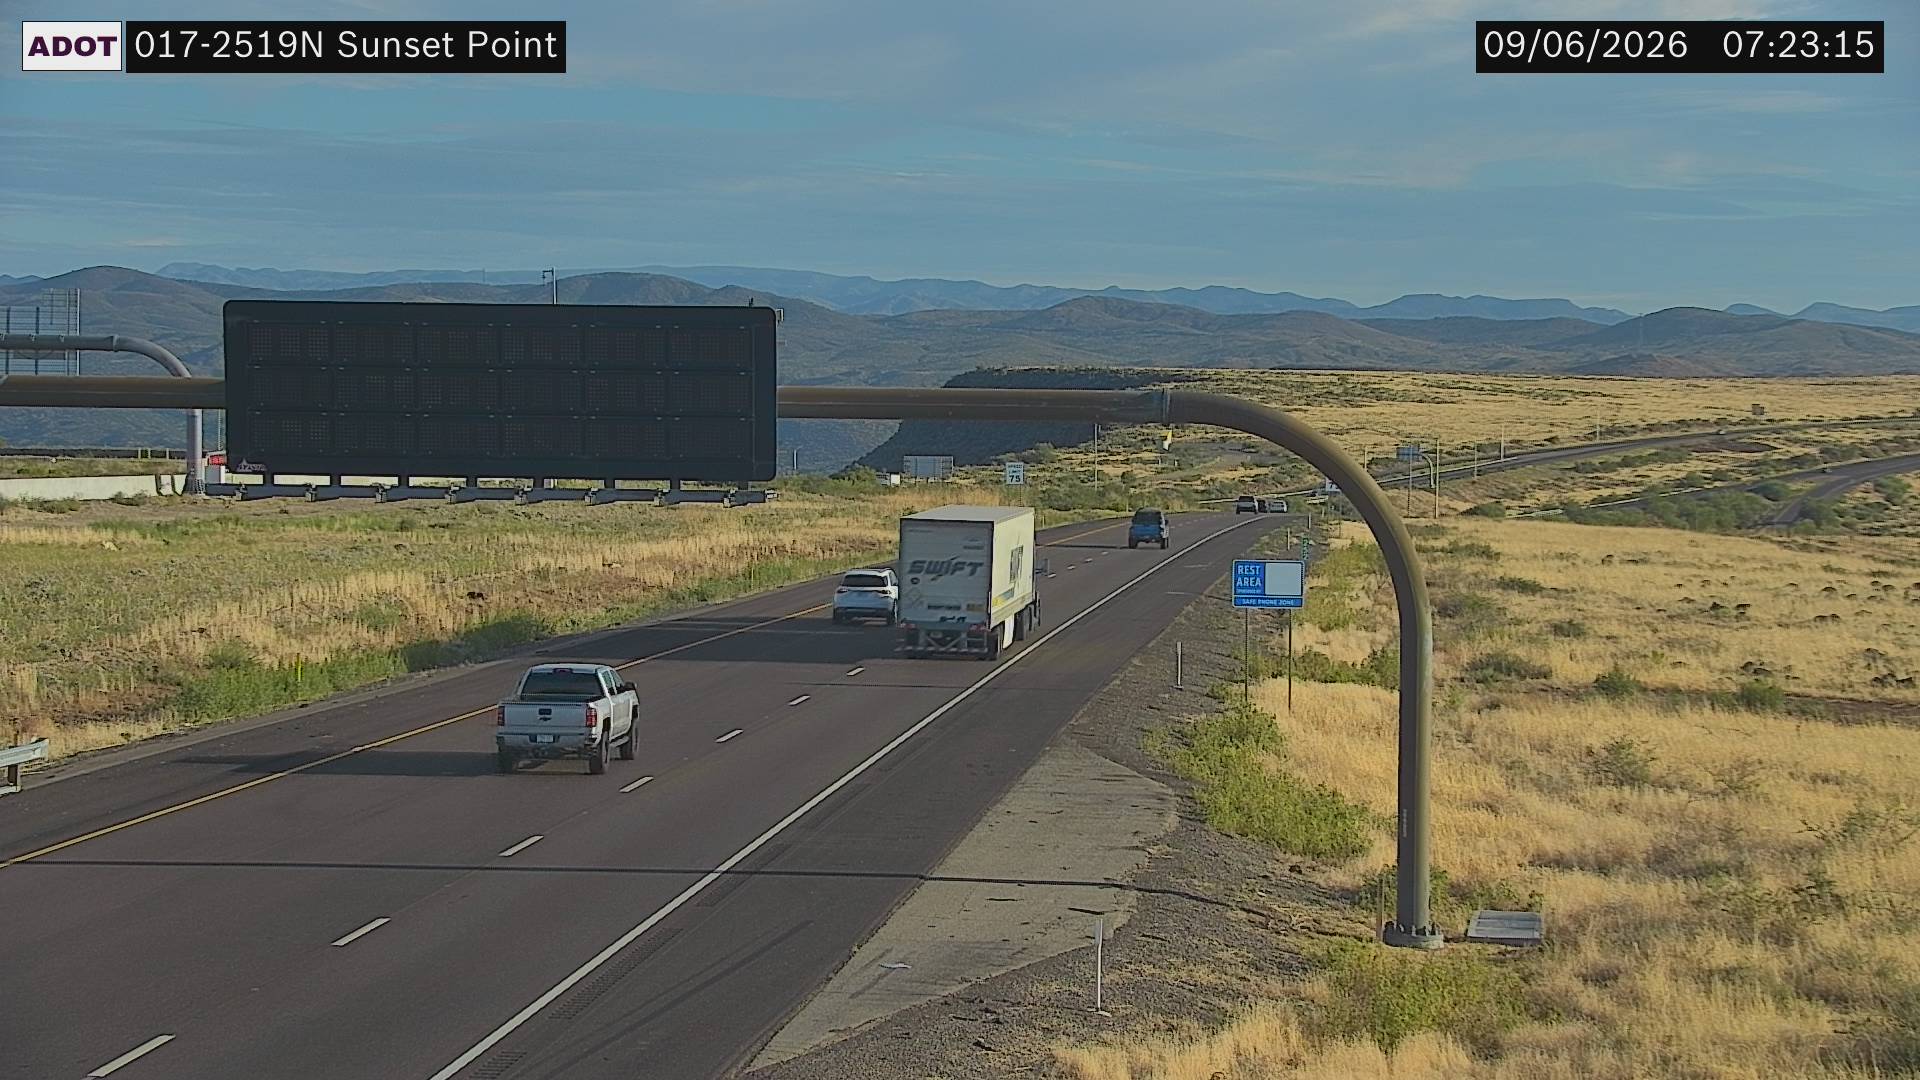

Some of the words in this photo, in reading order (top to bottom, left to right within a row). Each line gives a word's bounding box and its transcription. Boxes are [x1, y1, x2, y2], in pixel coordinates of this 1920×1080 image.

[1009, 475, 1021, 483] 75
[907, 558, 985, 577] SWIFT
[1237, 565, 1261, 575] REST
[1236, 577, 1262, 587] AREA
